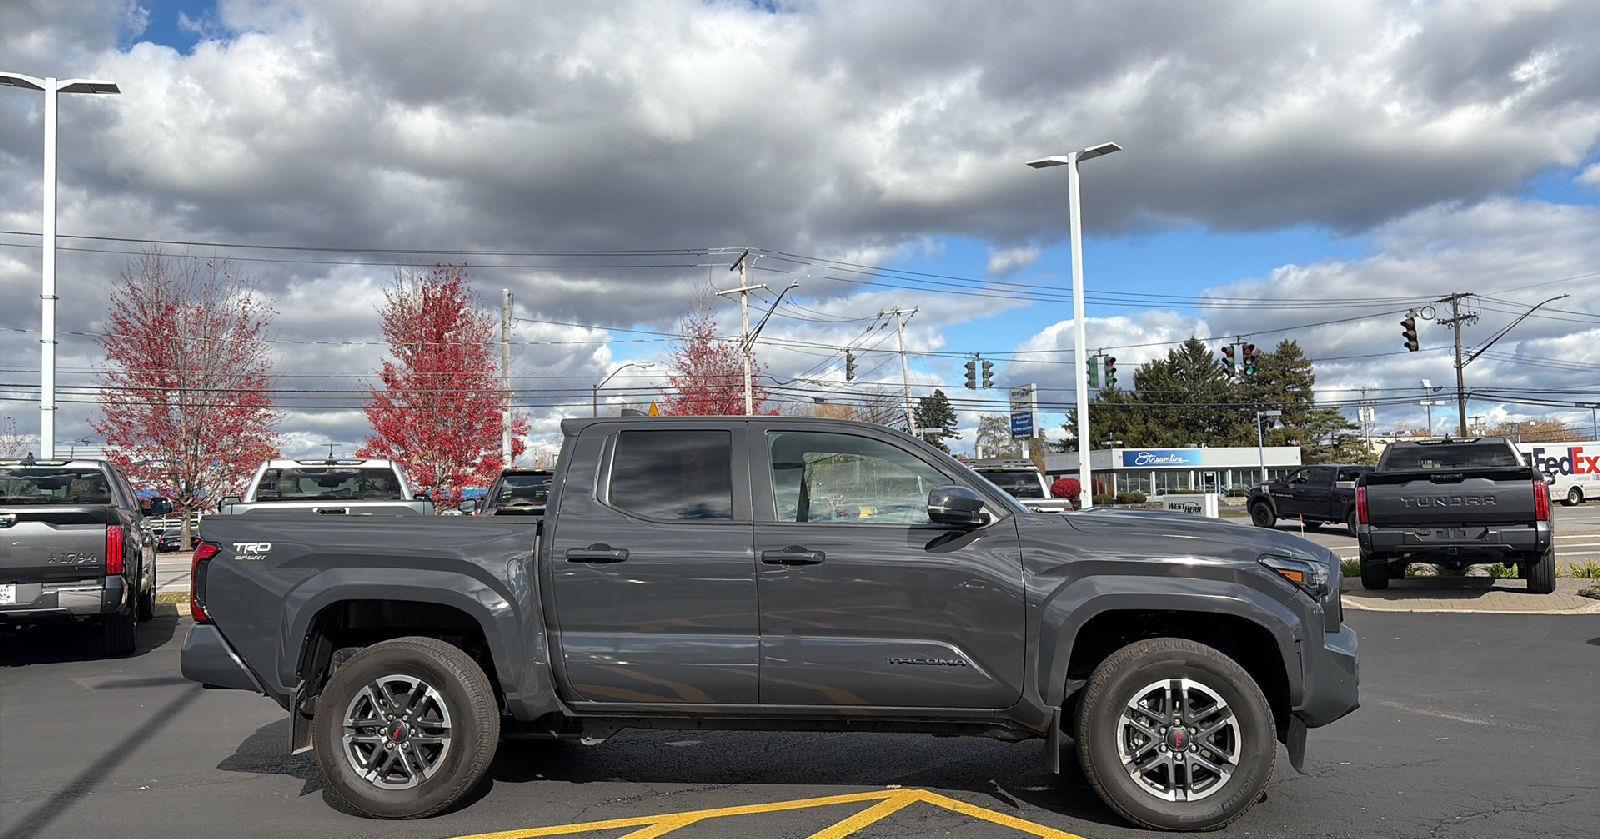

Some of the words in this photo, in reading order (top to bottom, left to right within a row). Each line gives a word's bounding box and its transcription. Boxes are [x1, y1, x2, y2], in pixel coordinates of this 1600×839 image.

[1533, 447, 1600, 476] FedEx
[1168, 502, 1185, 510] WEST
[1400, 496, 1496, 508] TUNDRA
[232, 542, 272, 554] TRD
[60, 552, 97, 564] 1794
[884, 657, 967, 666] TACOMA
